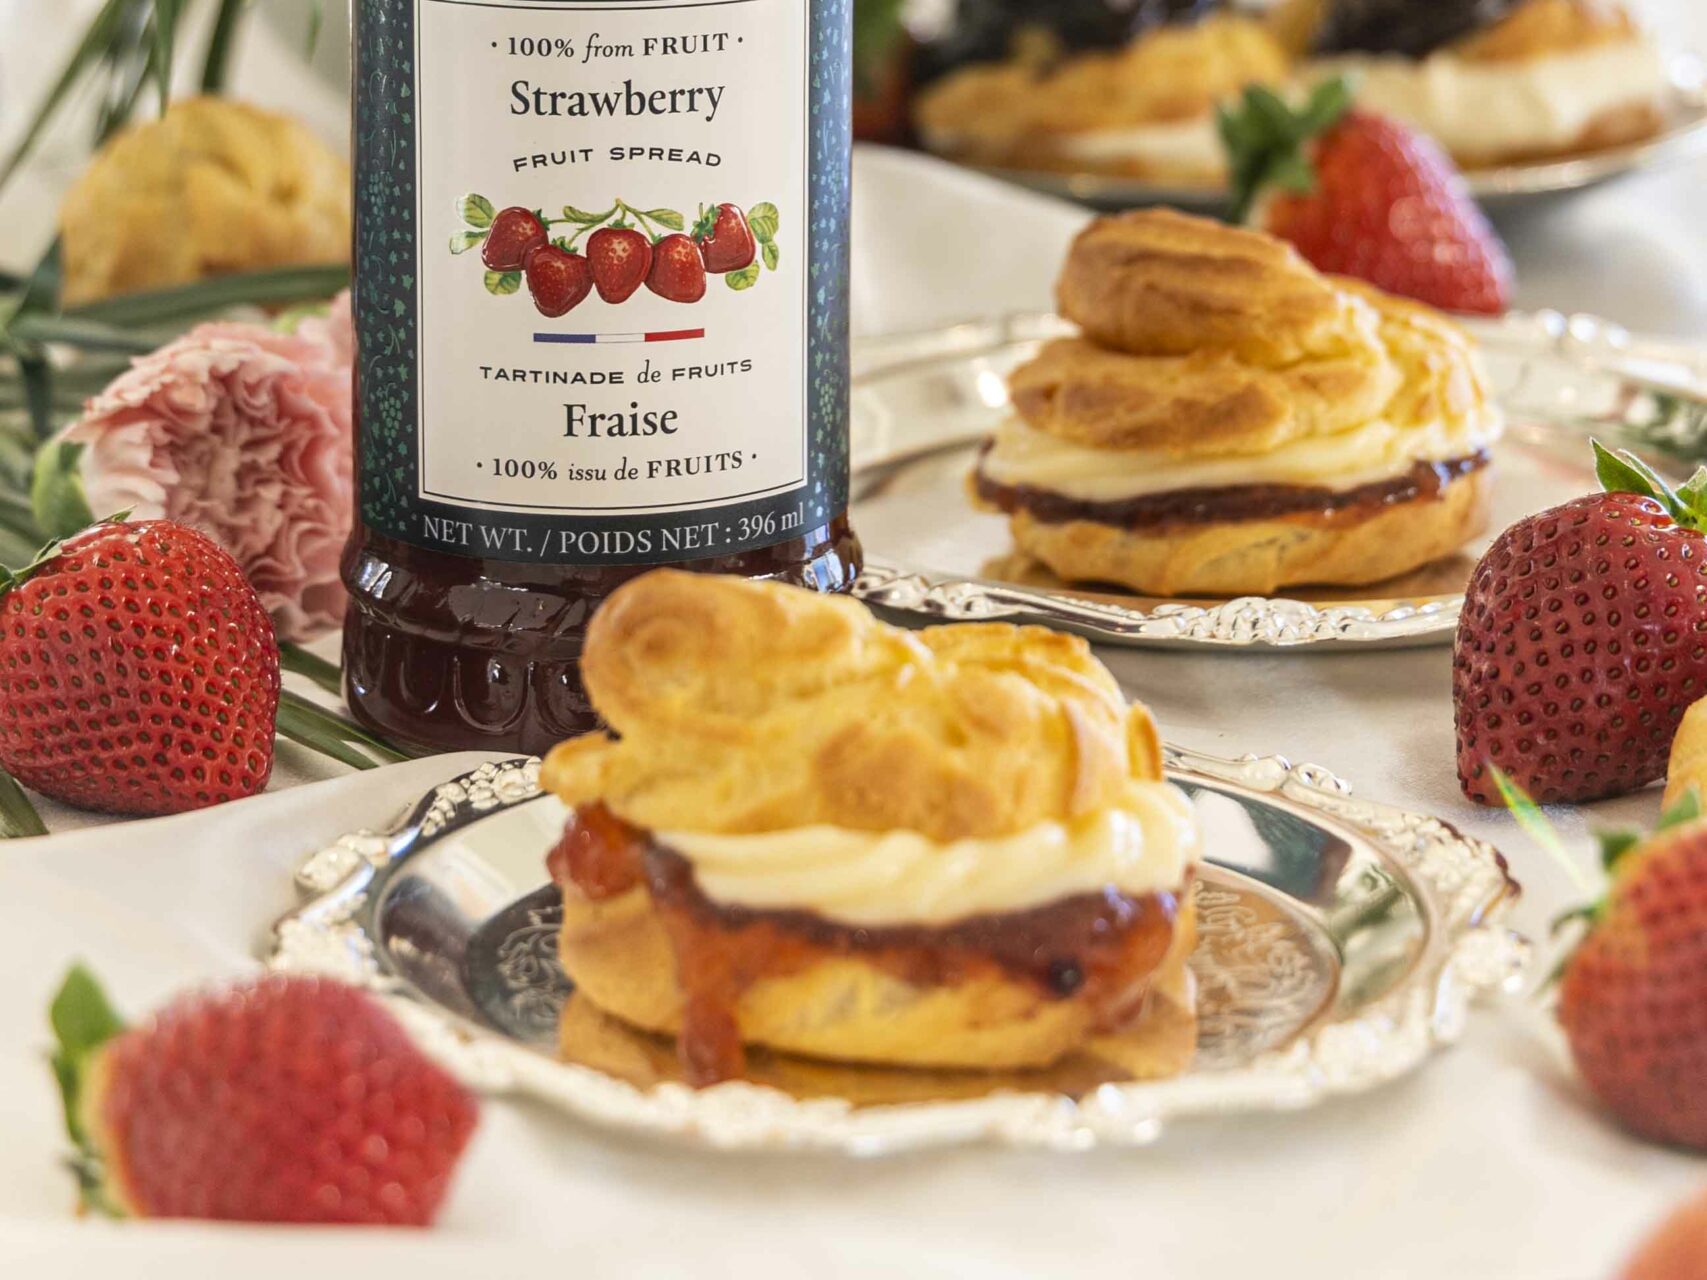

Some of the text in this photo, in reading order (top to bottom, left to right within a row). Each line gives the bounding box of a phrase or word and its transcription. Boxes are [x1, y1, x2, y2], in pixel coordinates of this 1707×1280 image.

[508, 32, 729, 63] 100% from FRUIT
[510, 79, 725, 121] Strawberry
[513, 146, 722, 172] FRUIT SPREAD
[480, 359, 753, 385] TARTINADE de FRUITS
[563, 401, 679, 438] Fraise
[492, 450, 743, 481] 100% issu de FRUITS
[423, 514, 473, 545] NET
[480, 525, 533, 552] WT.
[559, 529, 652, 554] POIDS
[738, 511, 776, 540] 396
[781, 502, 805, 532] ml
